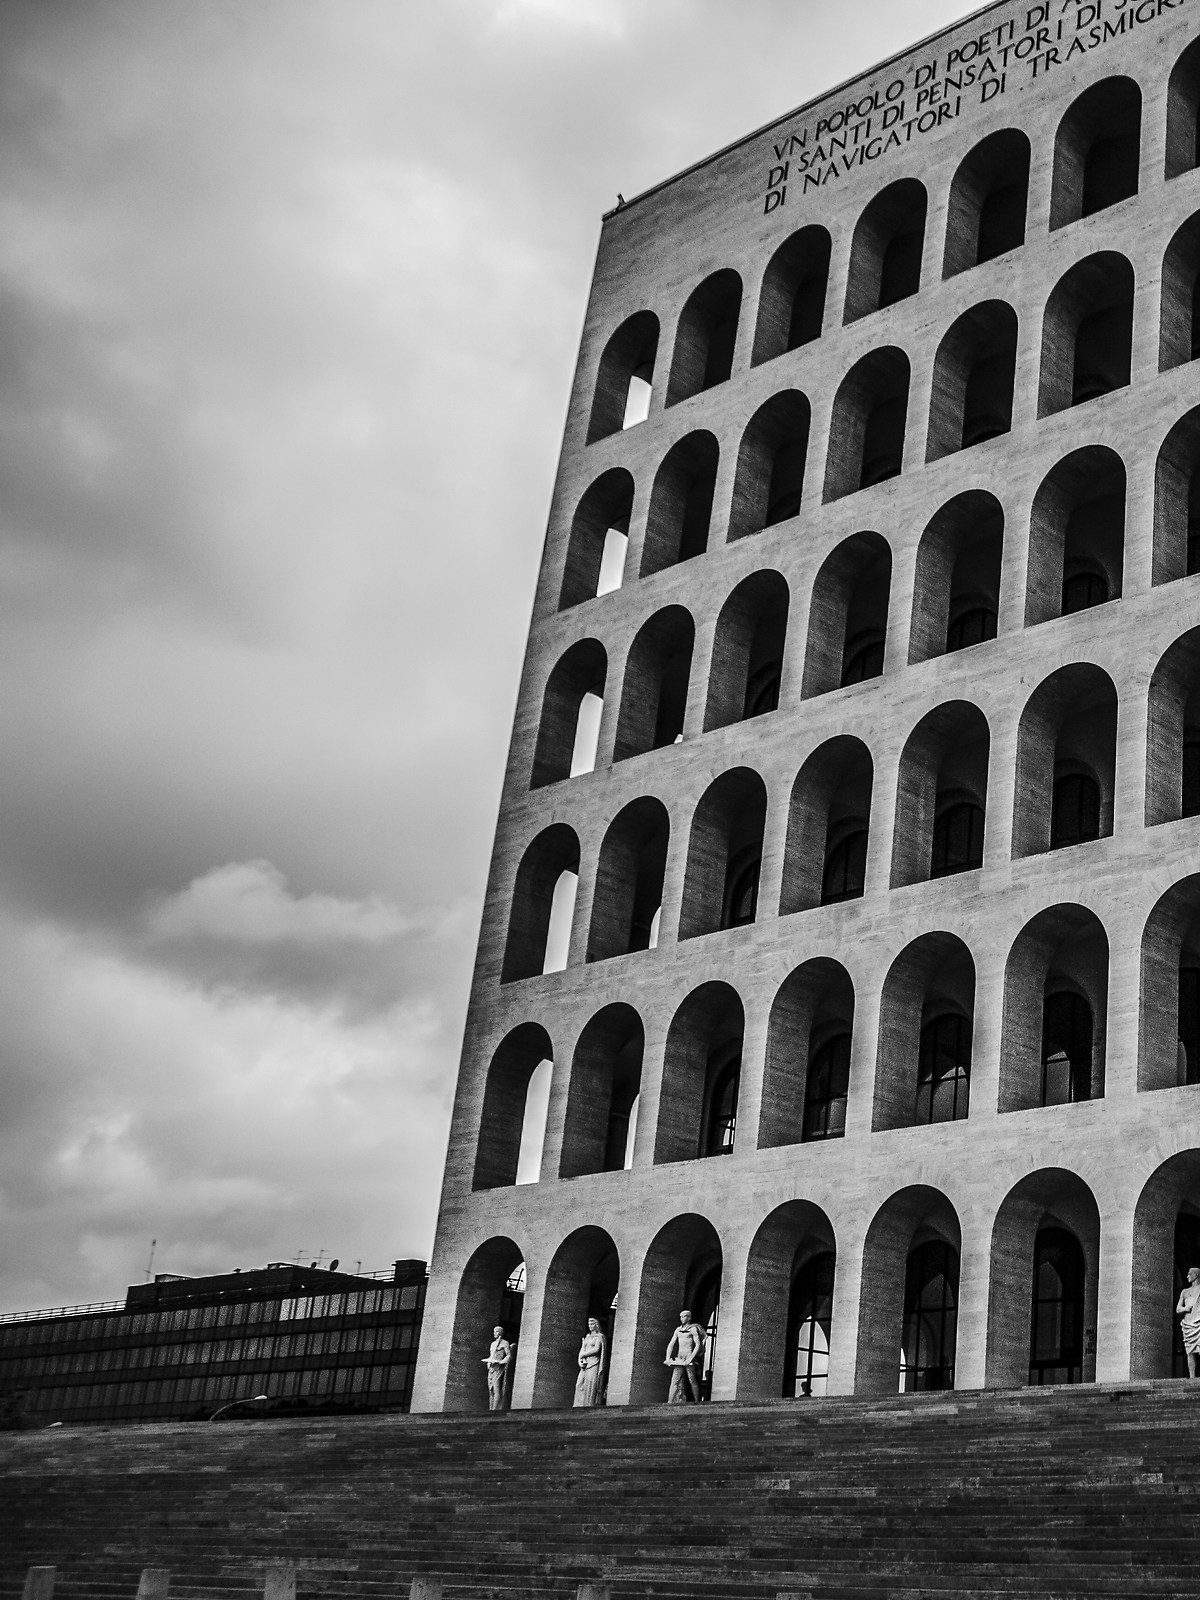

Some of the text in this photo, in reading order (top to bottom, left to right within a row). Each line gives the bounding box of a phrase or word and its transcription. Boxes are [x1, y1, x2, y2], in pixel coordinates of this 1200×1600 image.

[764, 0, 1183, 214] DI NAVIGATORI DI TRASMIGR
[768, 162, 789, 189] DI
[799, 118, 871, 172] SANTI
[881, 102, 904, 130] DI
[916, 20, 1063, 112] PENSATORI
[1076, 0, 1101, 30] DI
[772, 7, 1050, 161] VN POPOLO DI POETI DI
